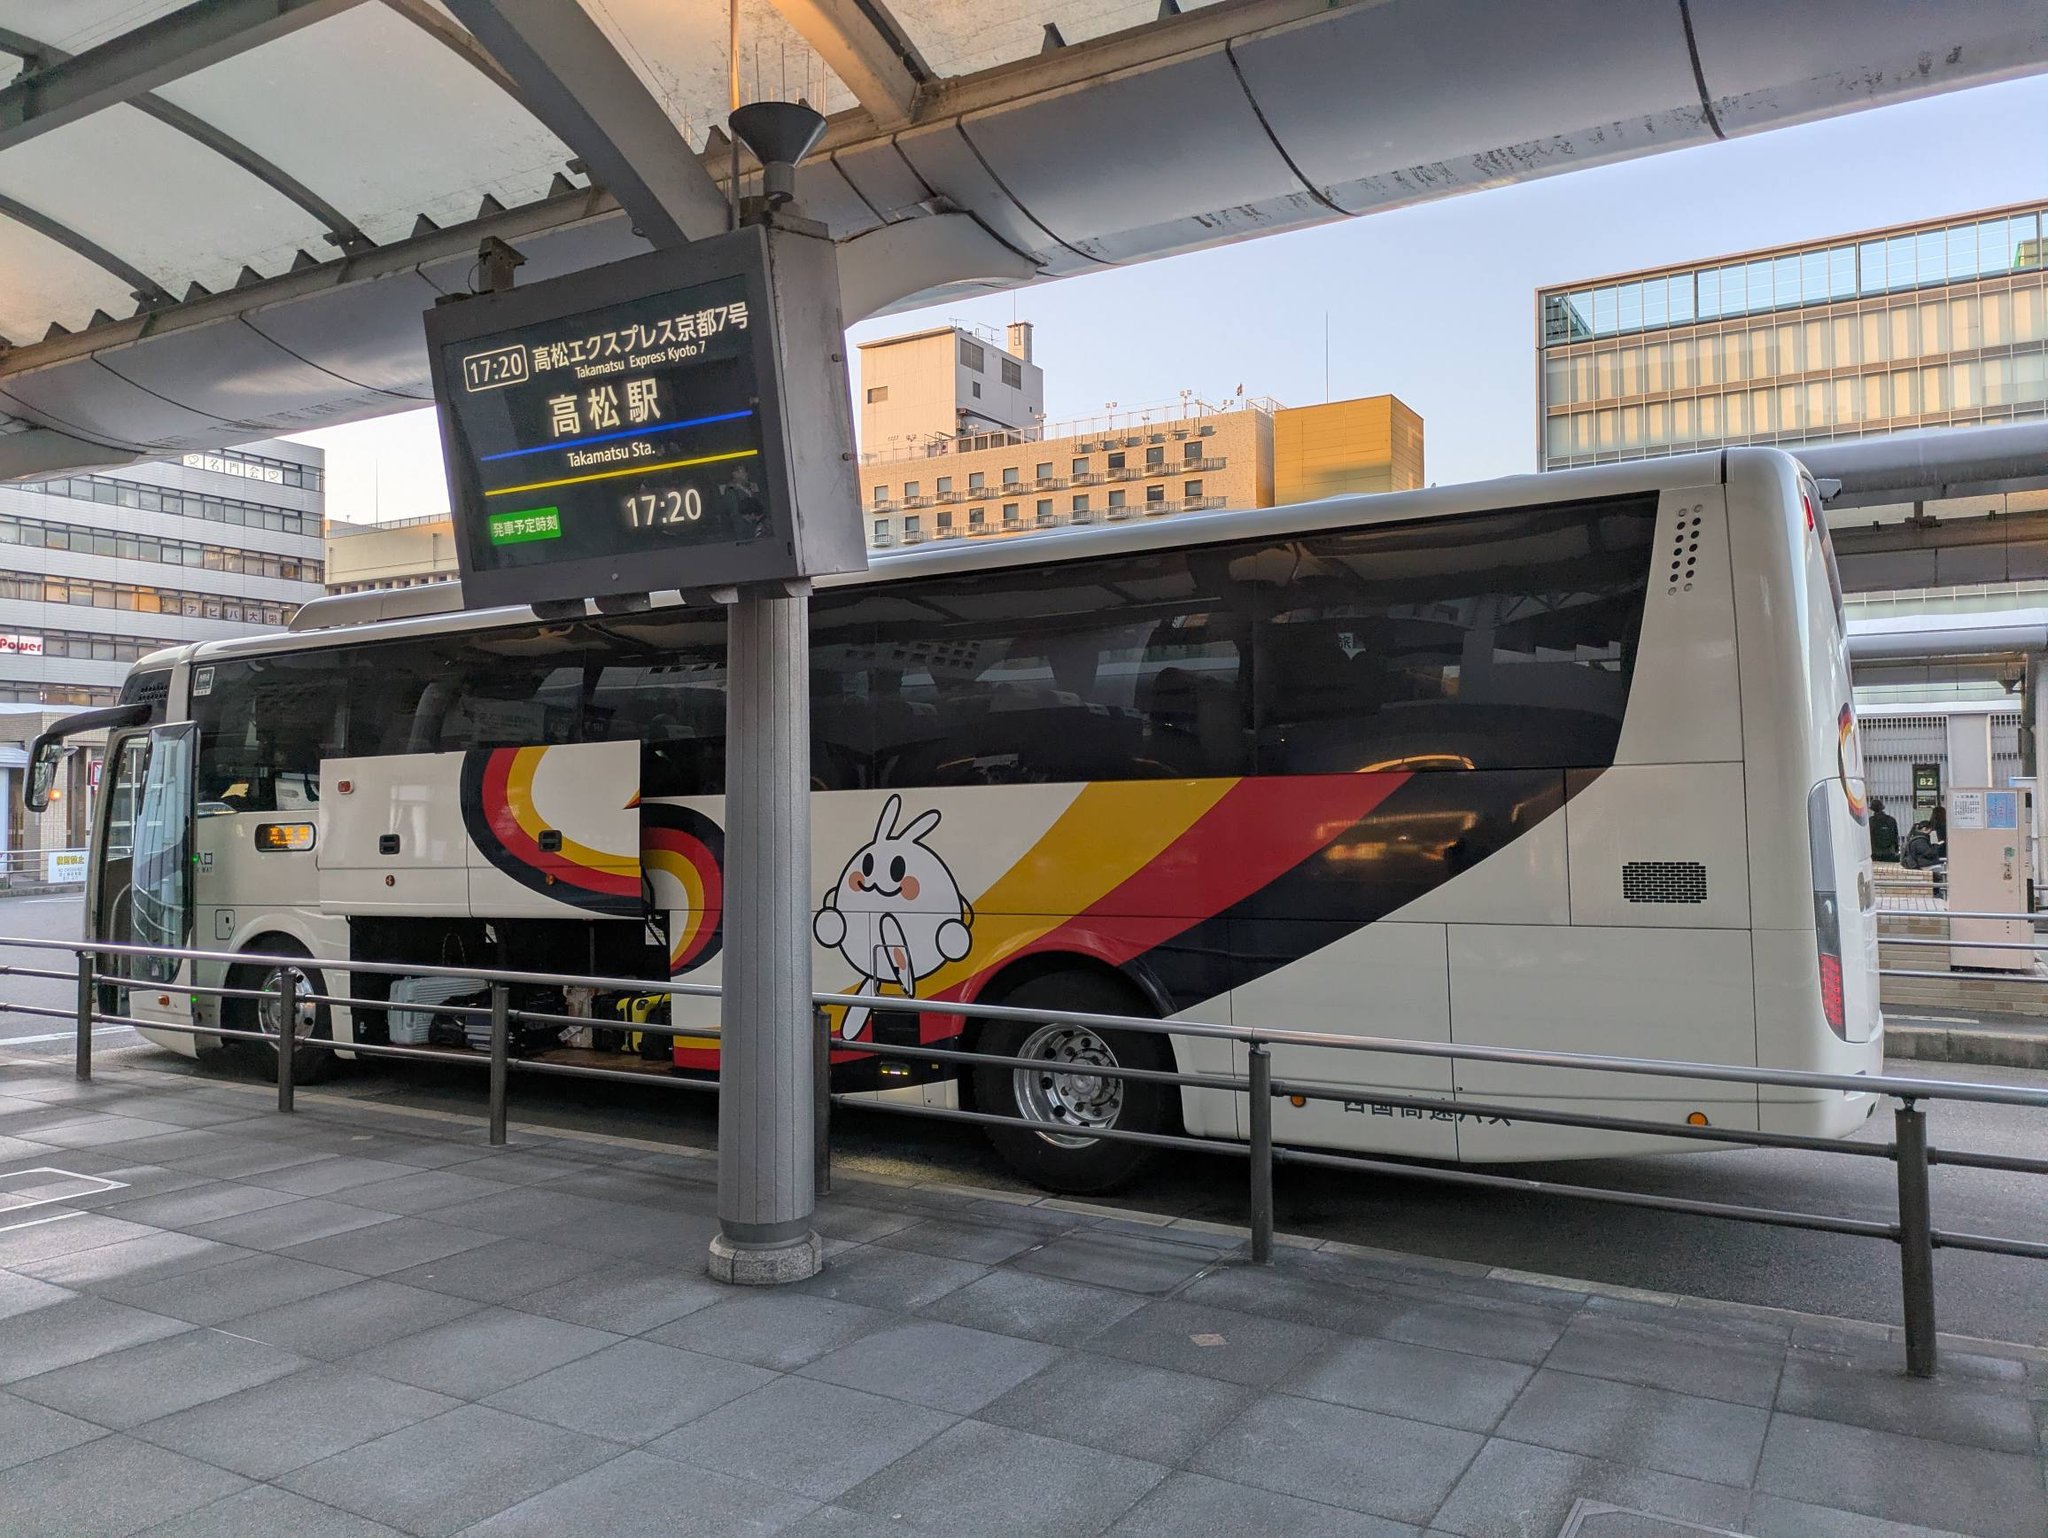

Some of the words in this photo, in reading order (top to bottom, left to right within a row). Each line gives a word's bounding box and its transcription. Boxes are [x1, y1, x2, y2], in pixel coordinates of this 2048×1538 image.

[532, 302, 749, 373] 高松エクスプレス京都7号
[470, 353, 522, 384] 17:20
[575, 359, 625, 379] Takamatsu
[629, 350, 666, 369] Express
[667, 345, 698, 363] Kyoto
[698, 340, 707, 354] 7
[548, 378, 661, 437] 高松駅
[567, 446, 629, 468] Takamatsu
[631, 442, 656, 457] Sta.
[493, 514, 558, 537] 発車予定時刻
[626, 488, 702, 527] 17:20
